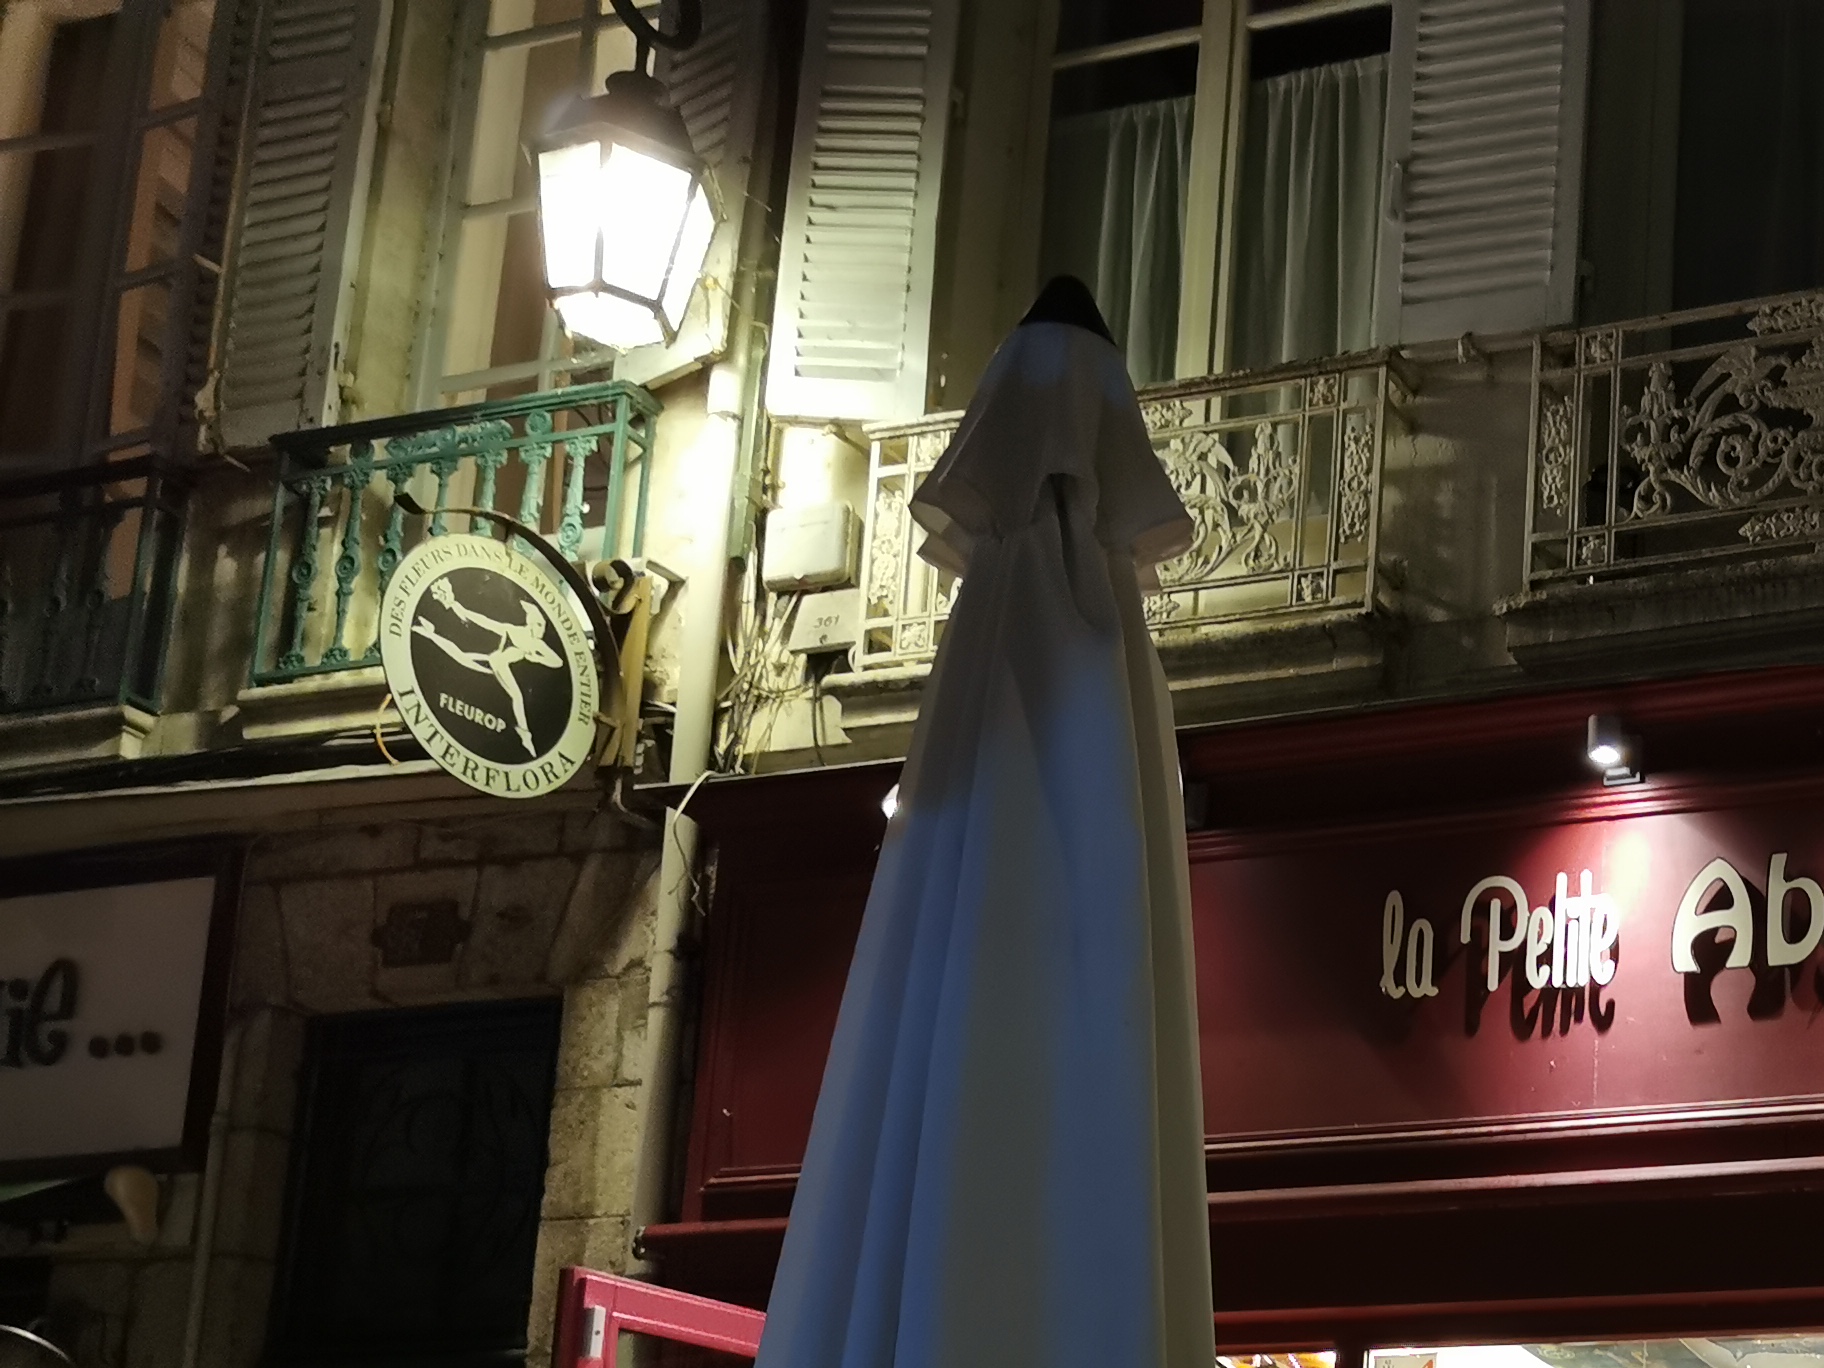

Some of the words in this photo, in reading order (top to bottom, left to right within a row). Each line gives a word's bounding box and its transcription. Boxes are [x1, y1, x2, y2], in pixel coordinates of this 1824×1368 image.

[389, 596, 407, 639] DES
[399, 545, 453, 600] FLEURS
[457, 542, 504, 564] DANS
[505, 550, 531, 581] LE
[530, 573, 580, 647] MONDE
[573, 650, 594, 727] ENTIER
[396, 685, 577, 793] INTERFLORA
[438, 692, 507, 733] FLEUROP
[1460, 868, 1620, 992] Petite
